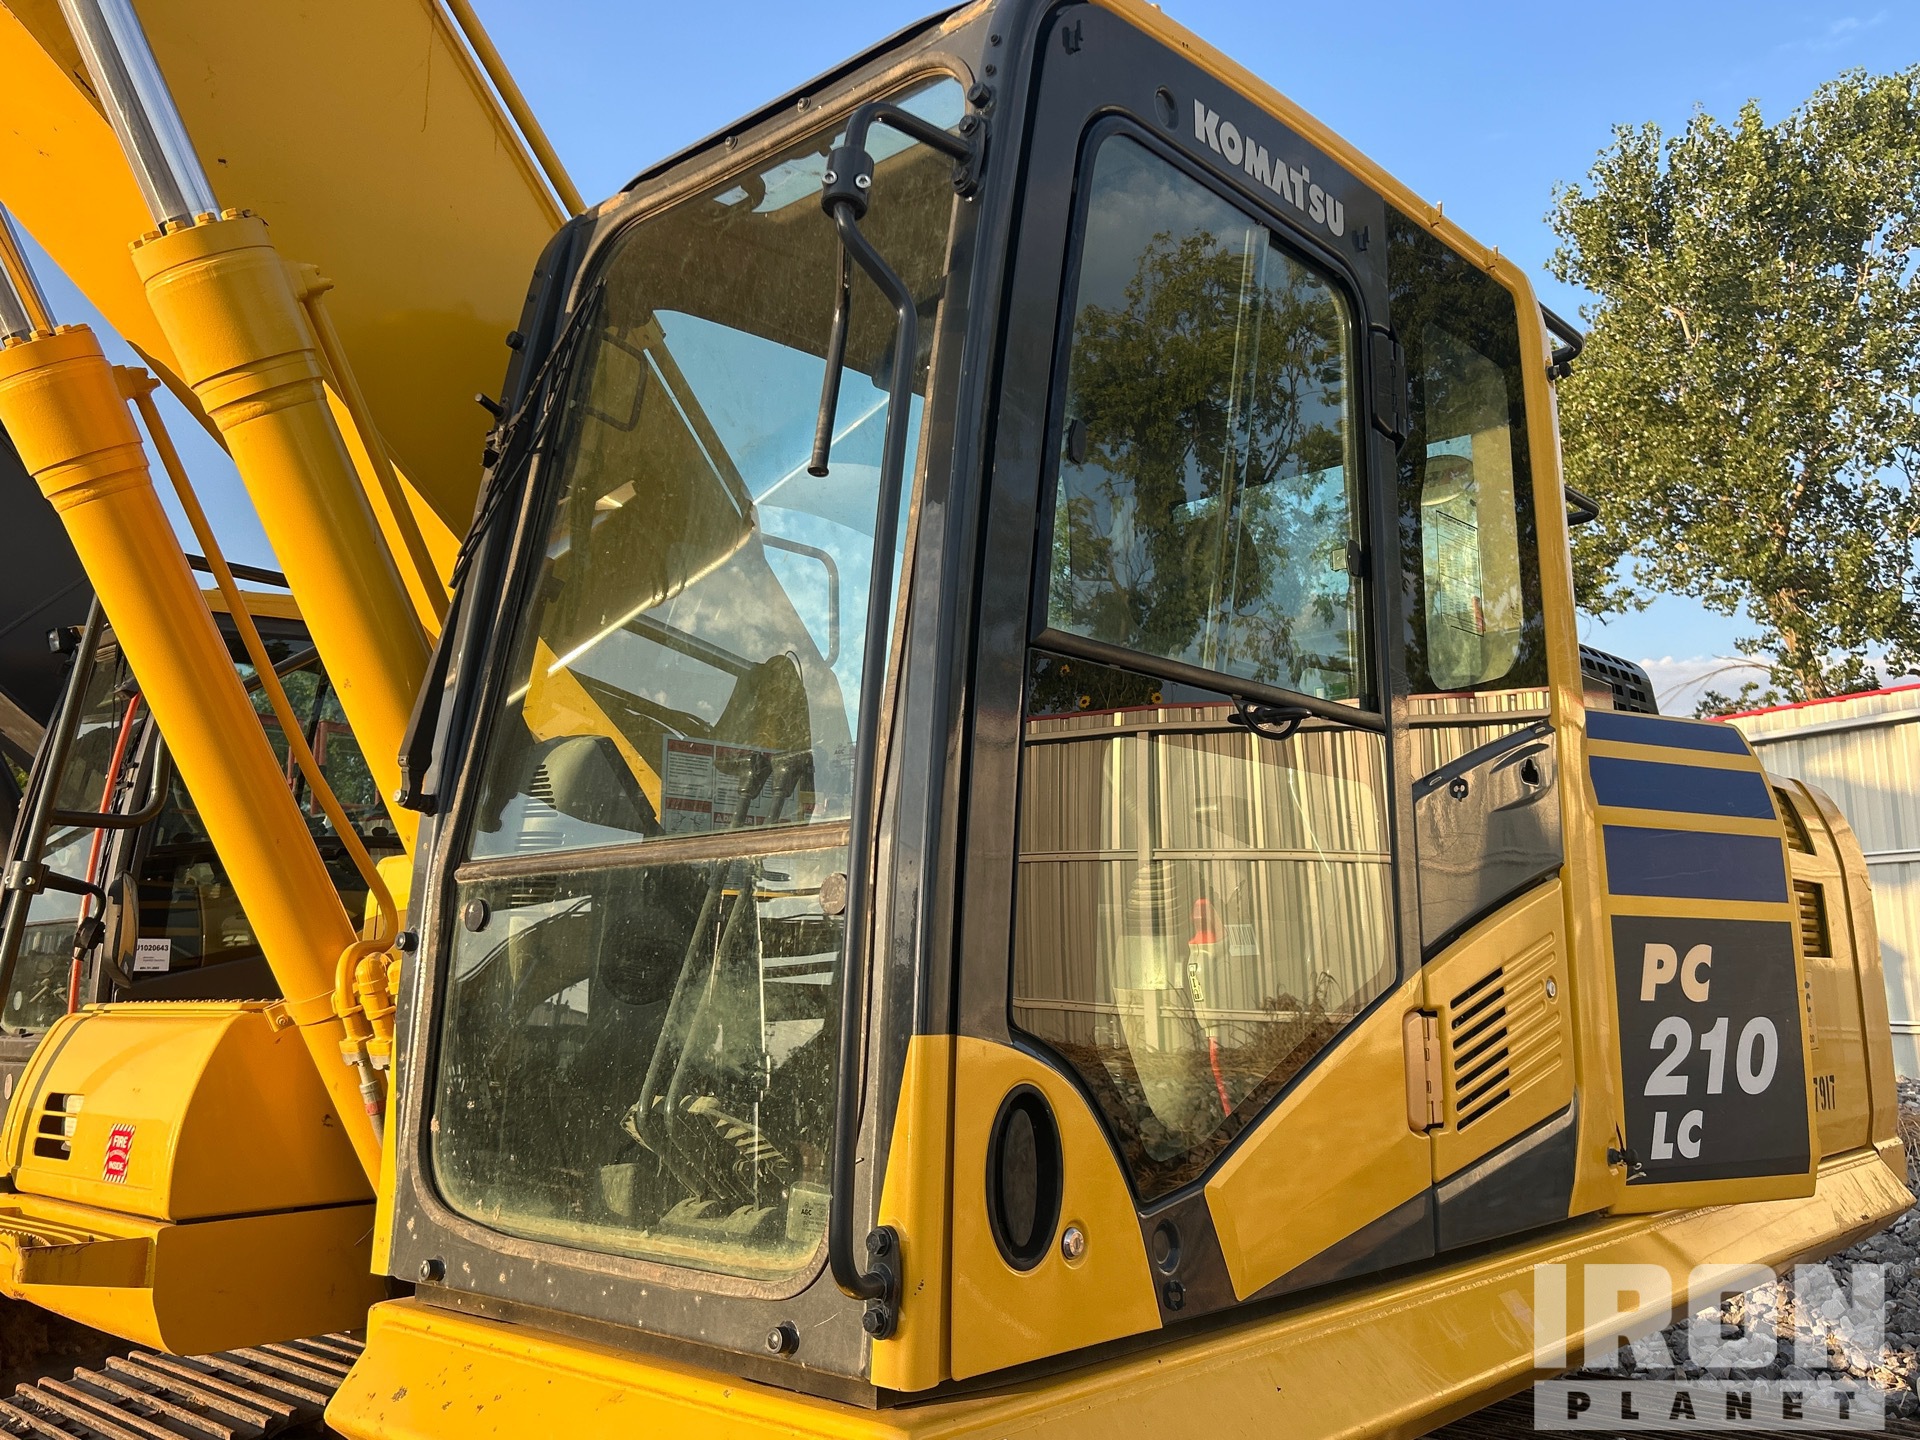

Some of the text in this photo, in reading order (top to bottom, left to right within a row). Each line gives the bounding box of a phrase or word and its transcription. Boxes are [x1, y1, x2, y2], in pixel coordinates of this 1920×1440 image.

[1194, 98, 1345, 237] KOMATSU
[1640, 943, 1713, 1003] PC
[1643, 1016, 1779, 1096] 210
[112, 1135, 129, 1149] FIRE
[1650, 1109, 1704, 1160] LC
